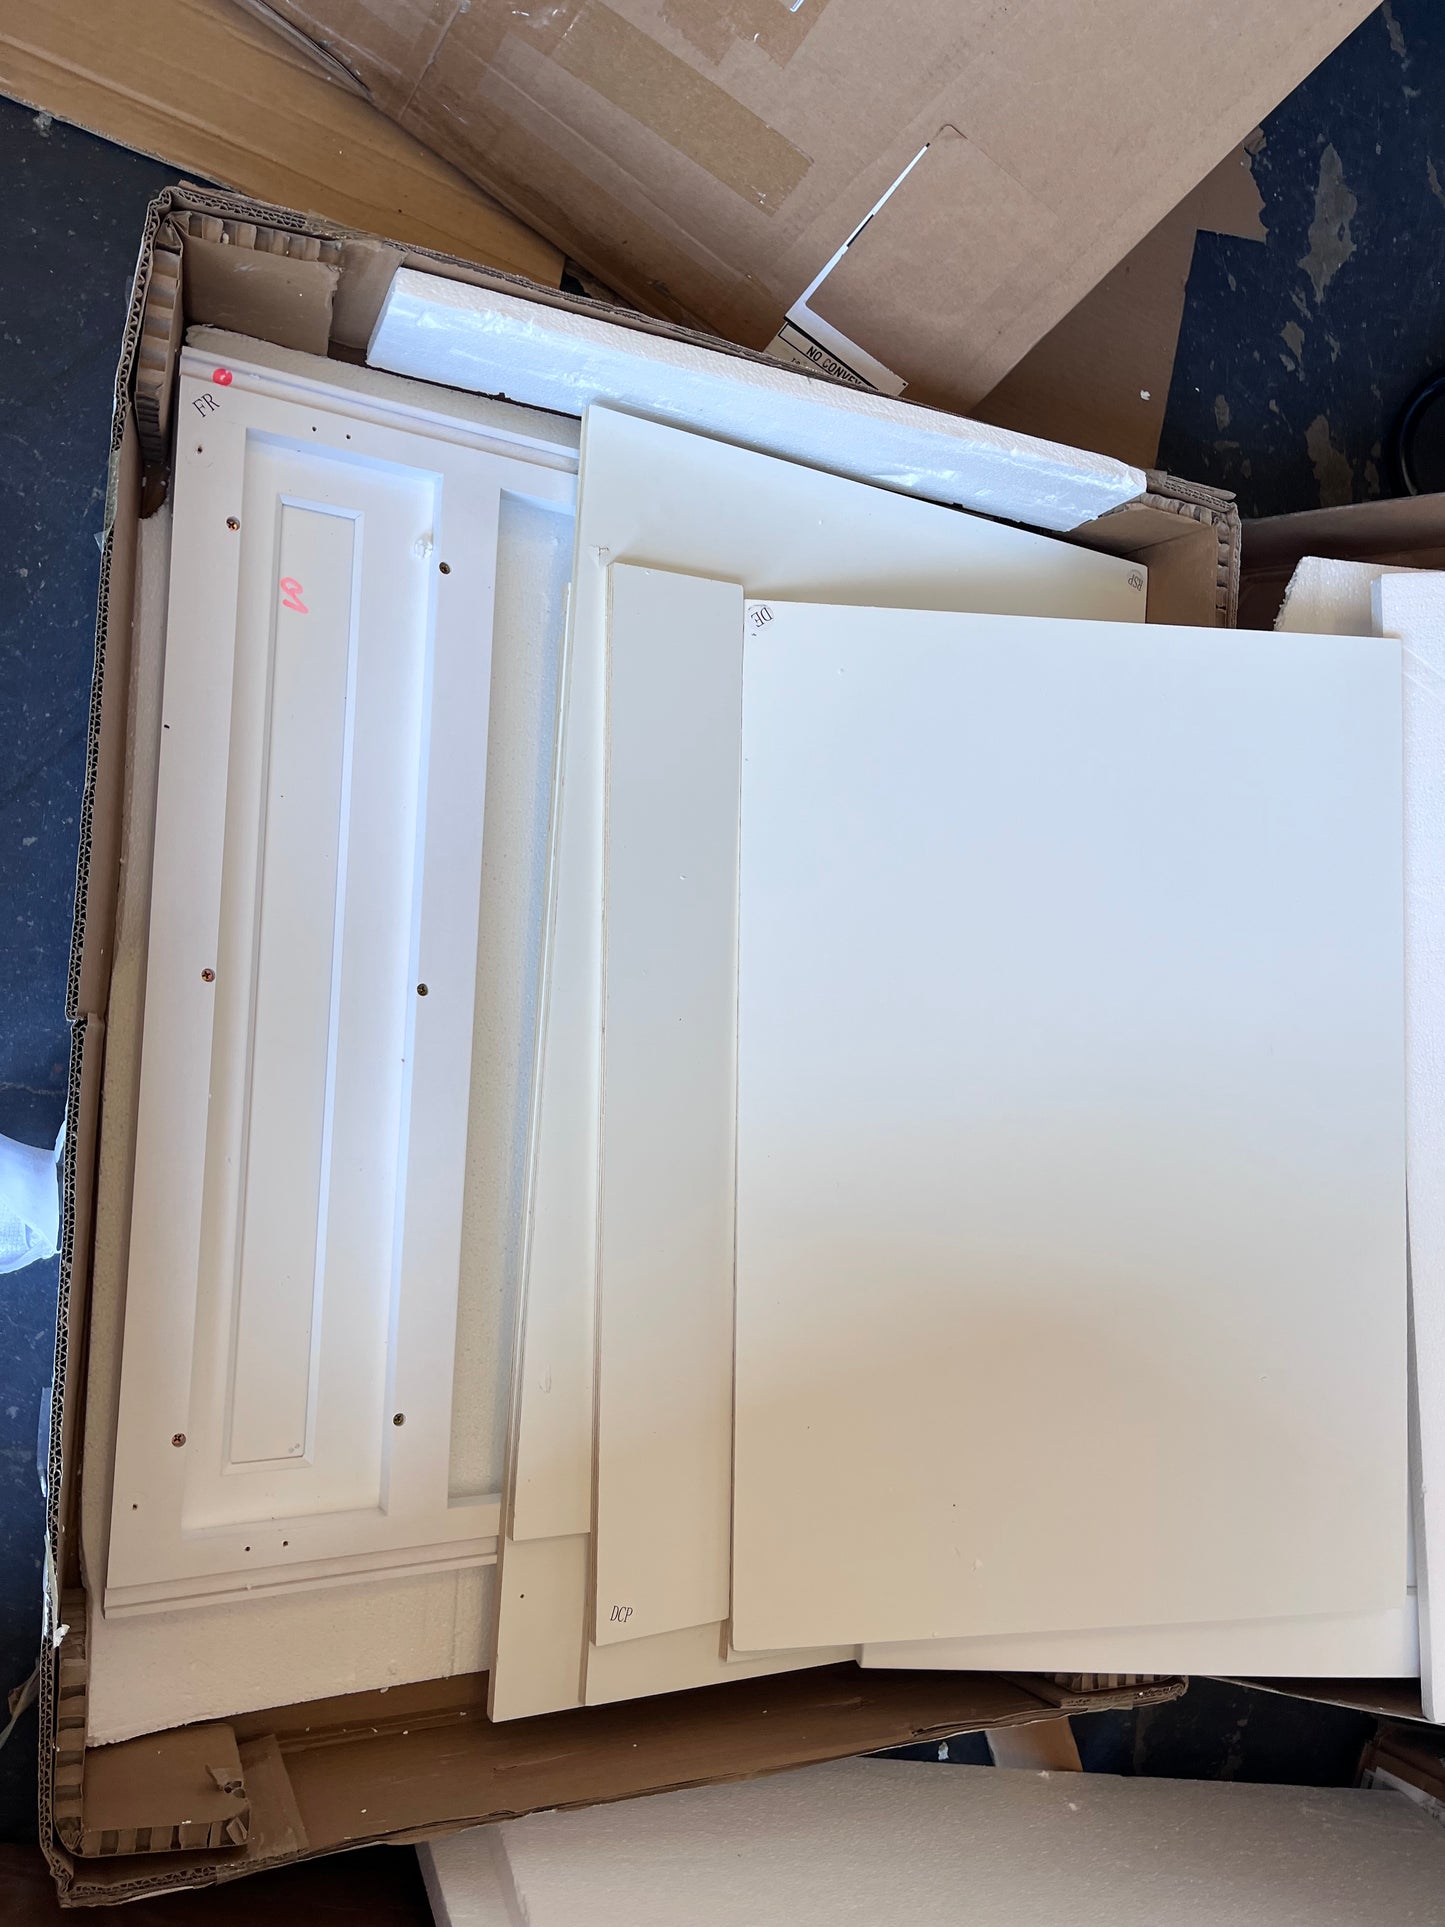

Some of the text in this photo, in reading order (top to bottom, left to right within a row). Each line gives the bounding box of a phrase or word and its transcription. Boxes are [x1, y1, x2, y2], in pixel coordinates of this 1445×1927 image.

[806, 345, 823, 361] NO
[192, 393, 220, 417] FR
[750, 607, 773, 628] DE
[609, 1605, 634, 1623] DCP
